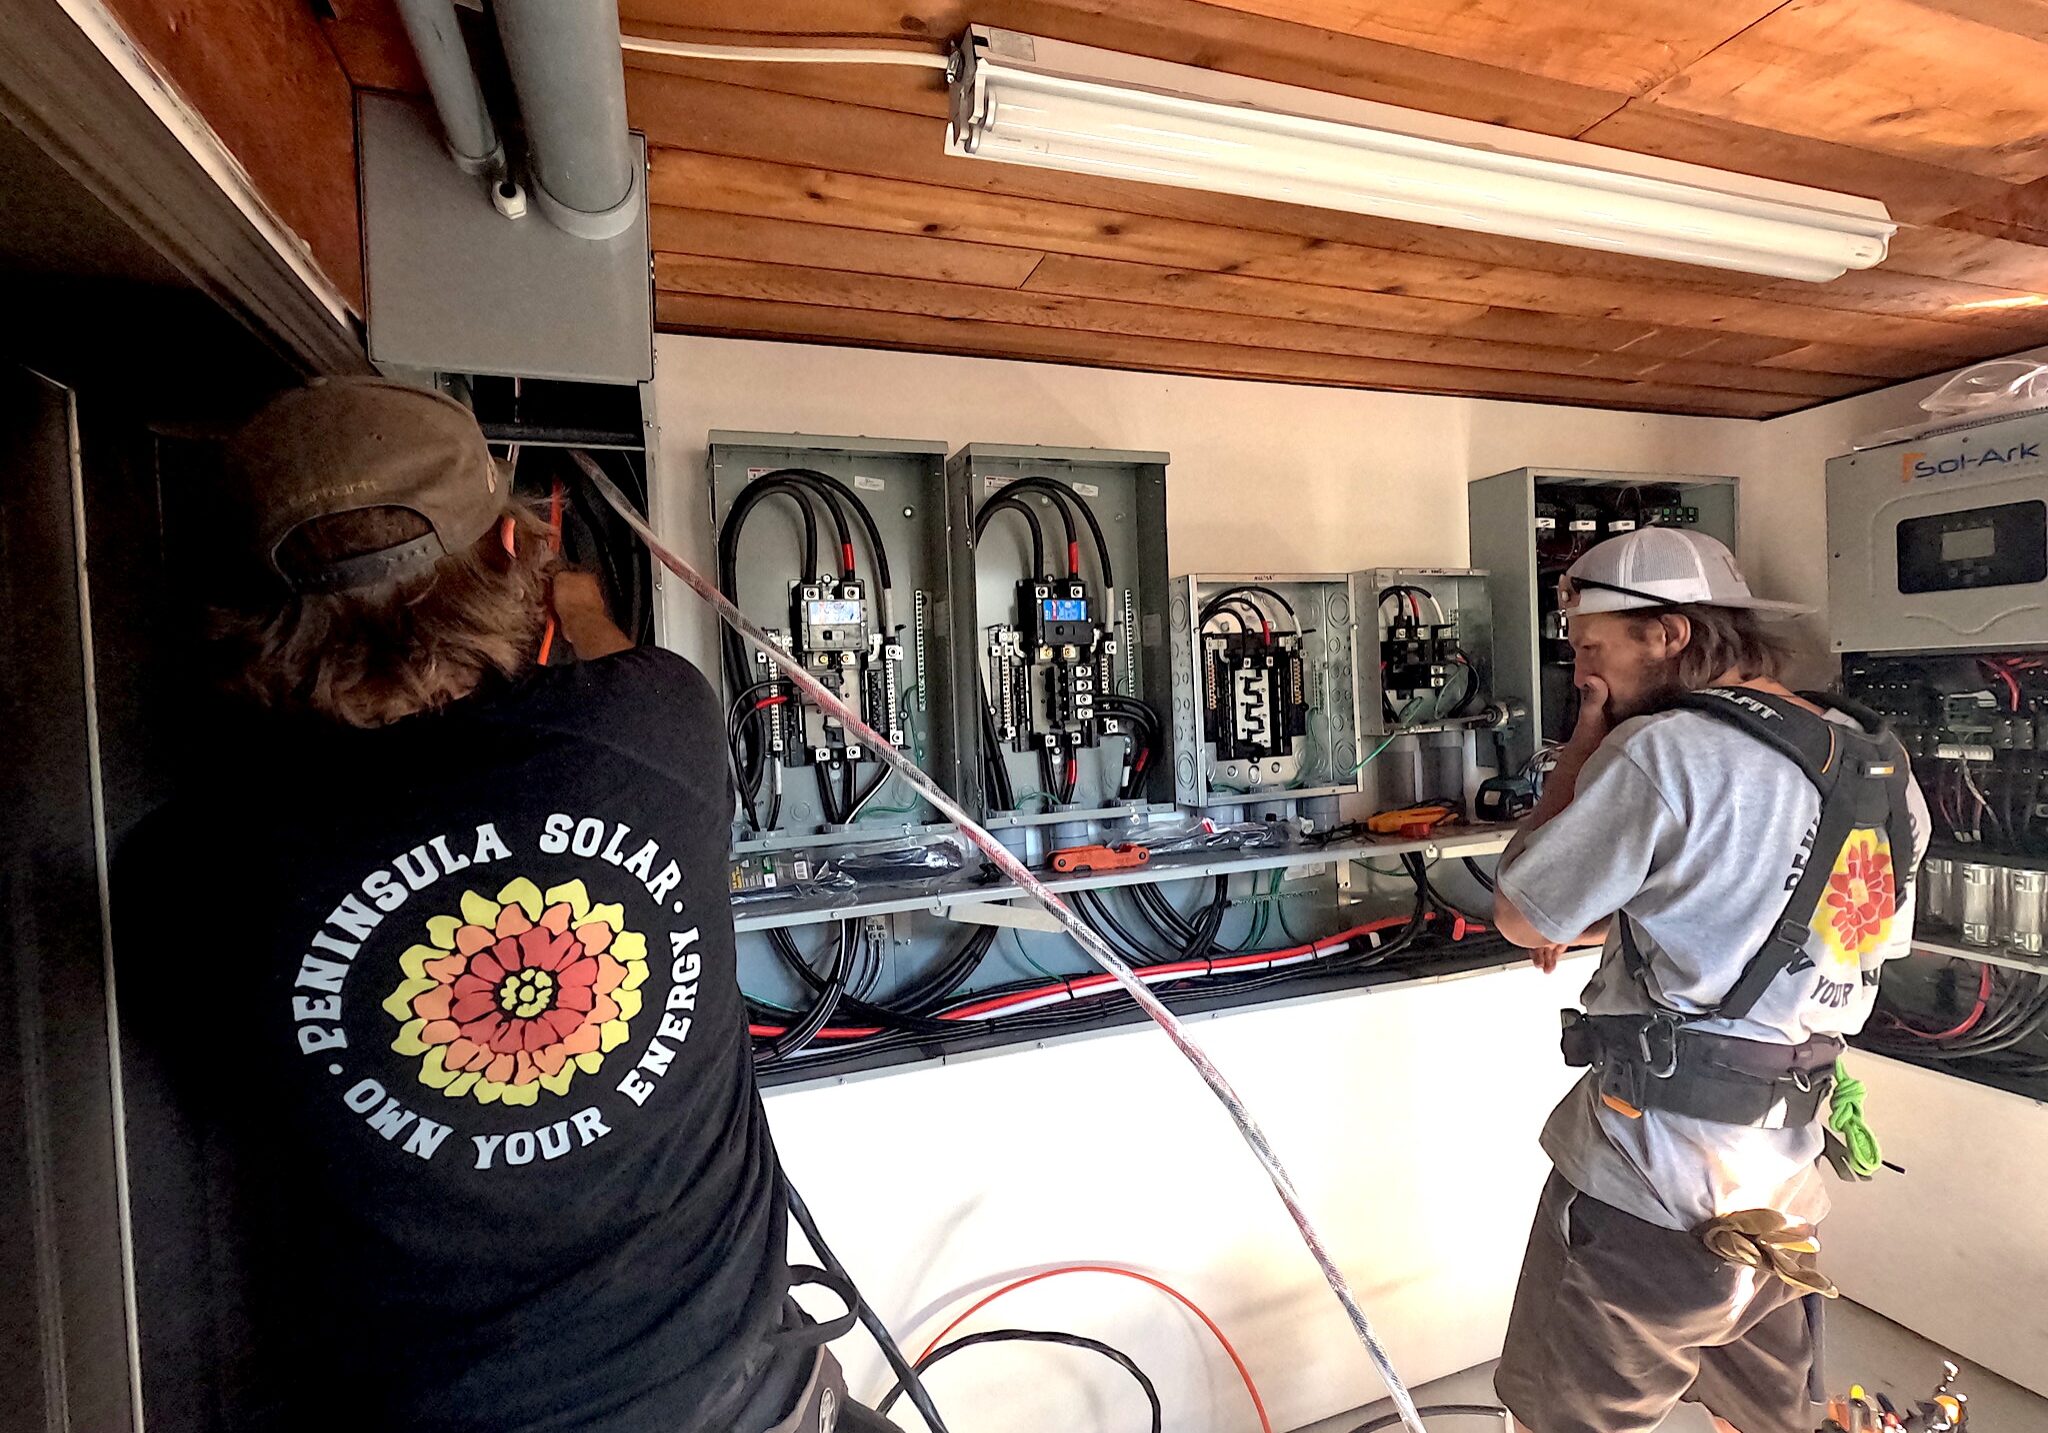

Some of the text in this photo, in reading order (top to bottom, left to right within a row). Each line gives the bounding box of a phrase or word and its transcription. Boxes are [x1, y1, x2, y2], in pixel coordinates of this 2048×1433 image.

[1914, 442, 2040, 479] Sol-Ark
[291, 813, 684, 1055] PENINSULA SOLAR
[1810, 974, 1854, 1008] YOUR
[343, 927, 702, 1170] OWN YOUR ENERGY
